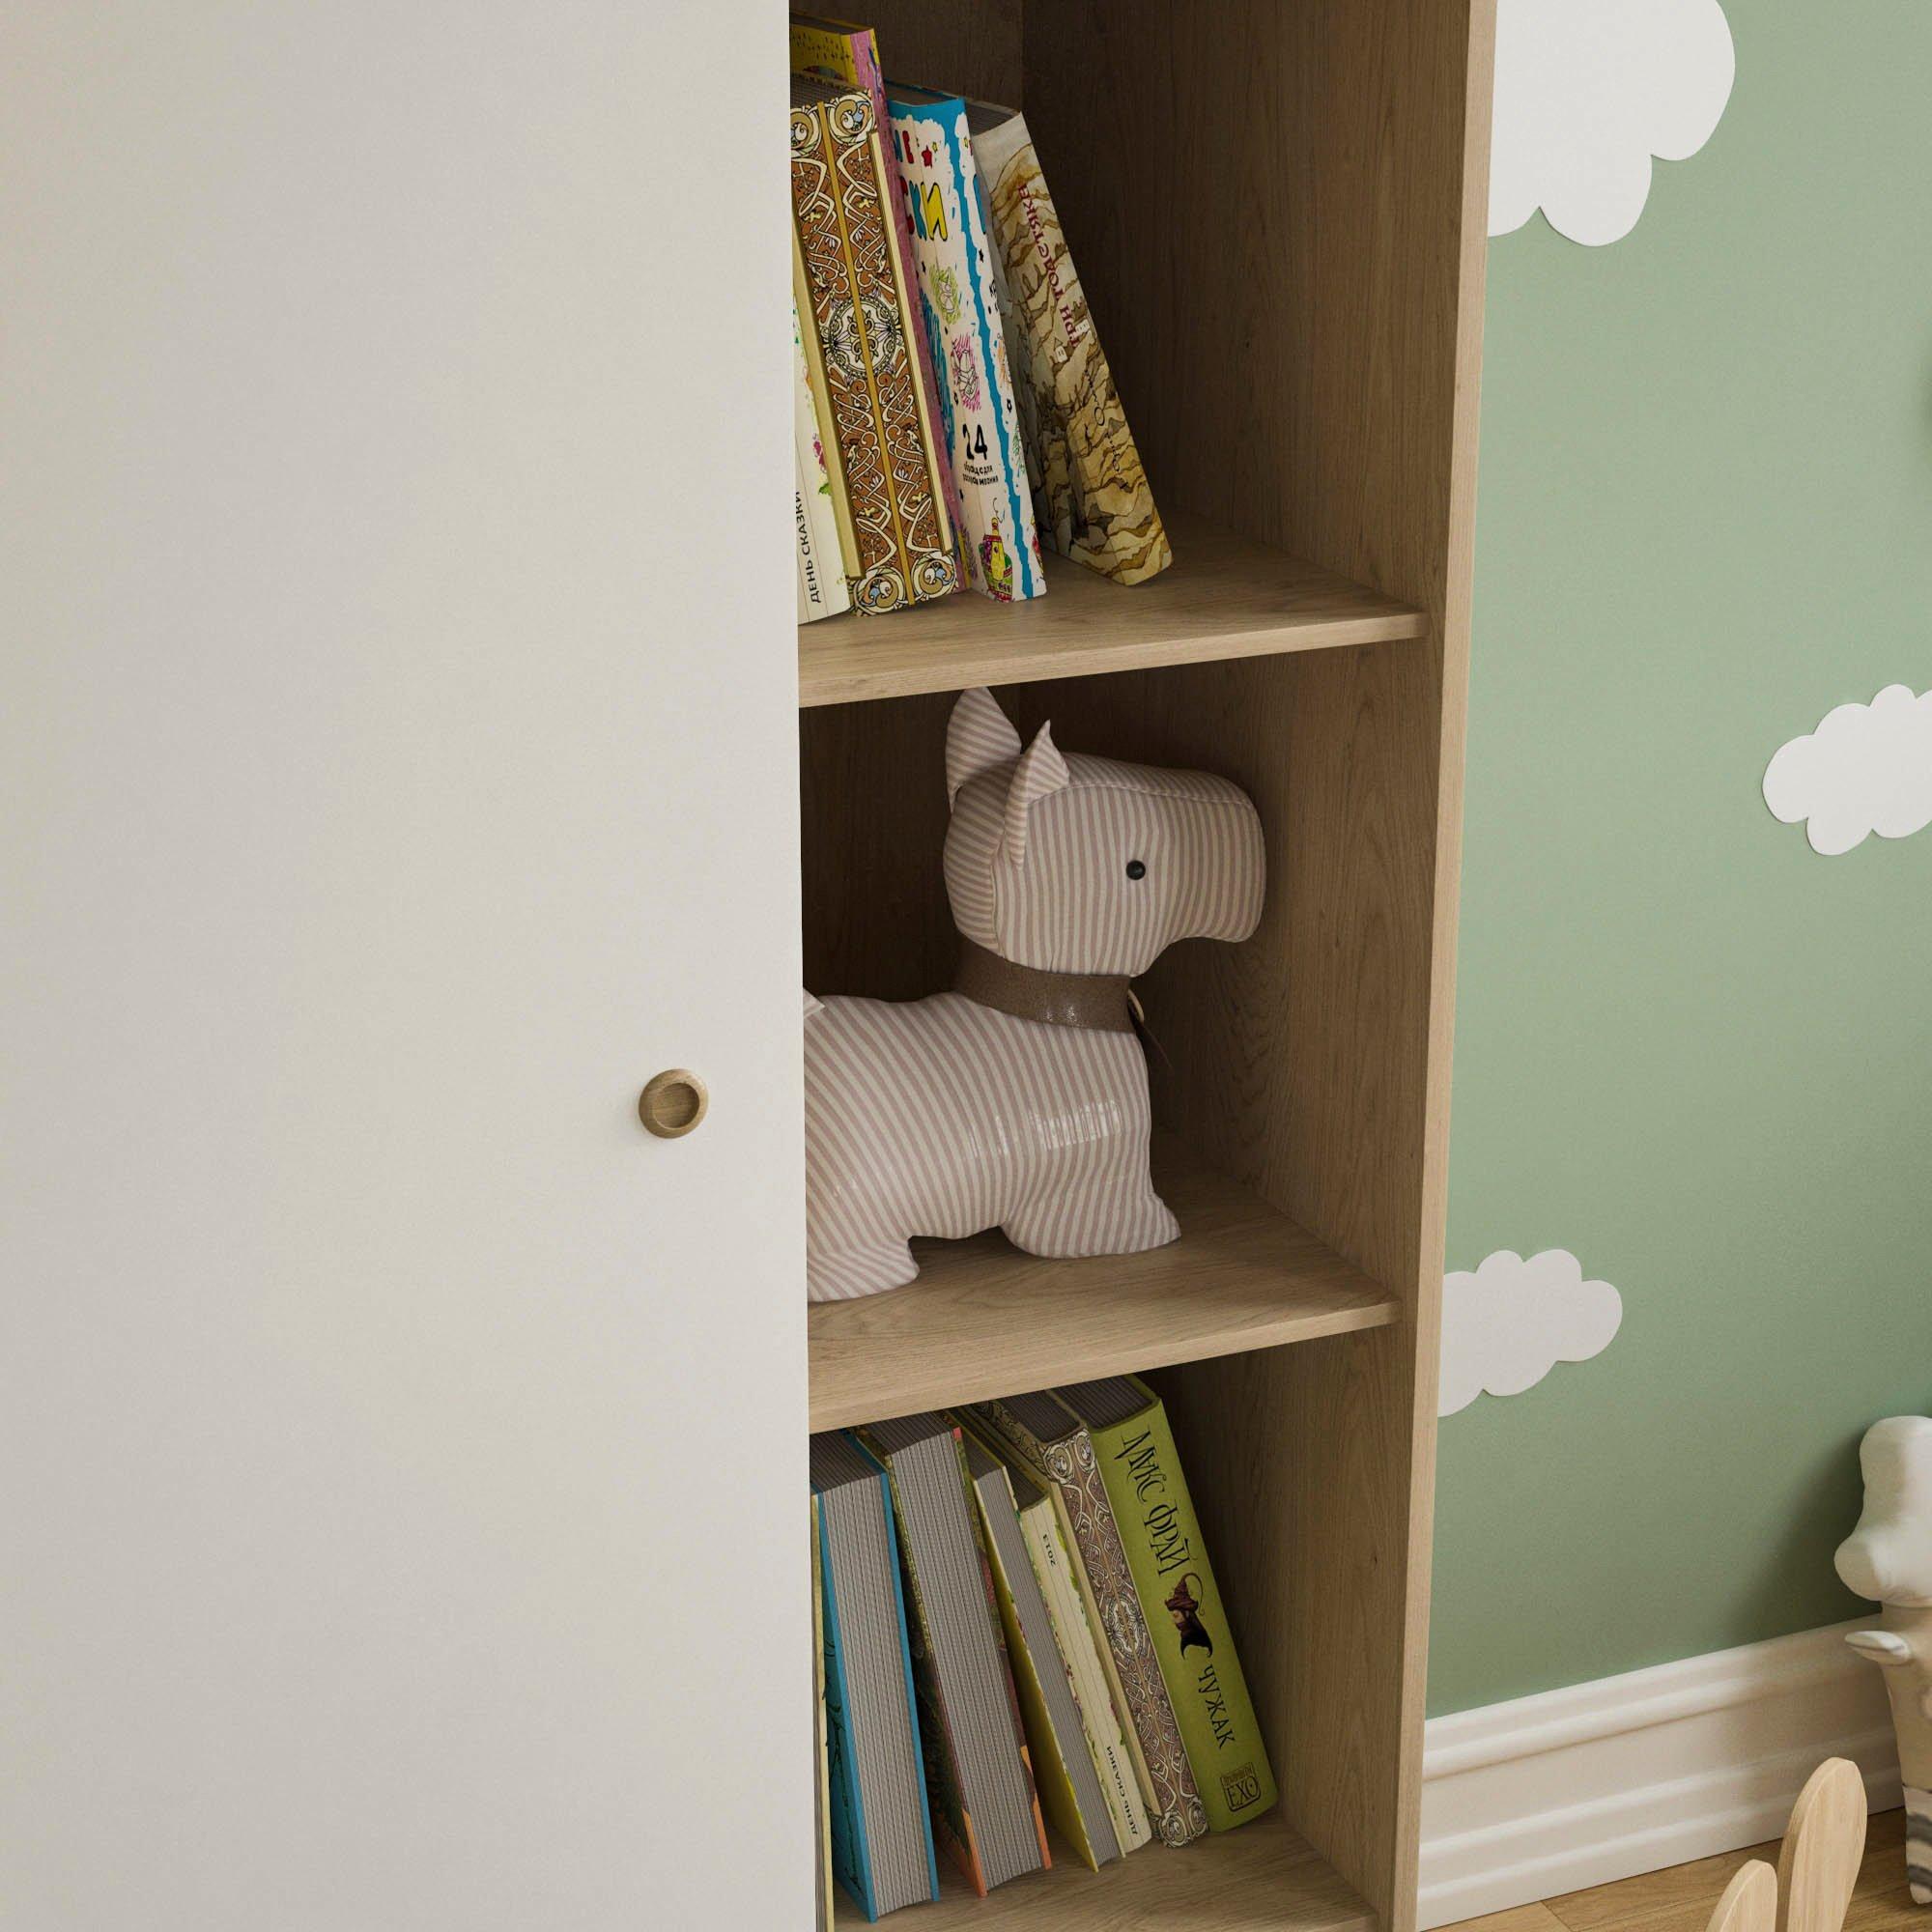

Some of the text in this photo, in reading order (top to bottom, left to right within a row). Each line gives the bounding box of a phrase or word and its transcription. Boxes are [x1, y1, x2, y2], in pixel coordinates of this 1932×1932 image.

[962, 423, 988, 461] 24
[806, 559, 822, 604] ДЕНЬ
[1114, 1425, 1197, 1577] МАКС ФРАЙ
[1198, 1663, 1236, 1750] ЧУЖАК
[1106, 1746, 1138, 1835] ДЕНЬ СКАЗКИ
